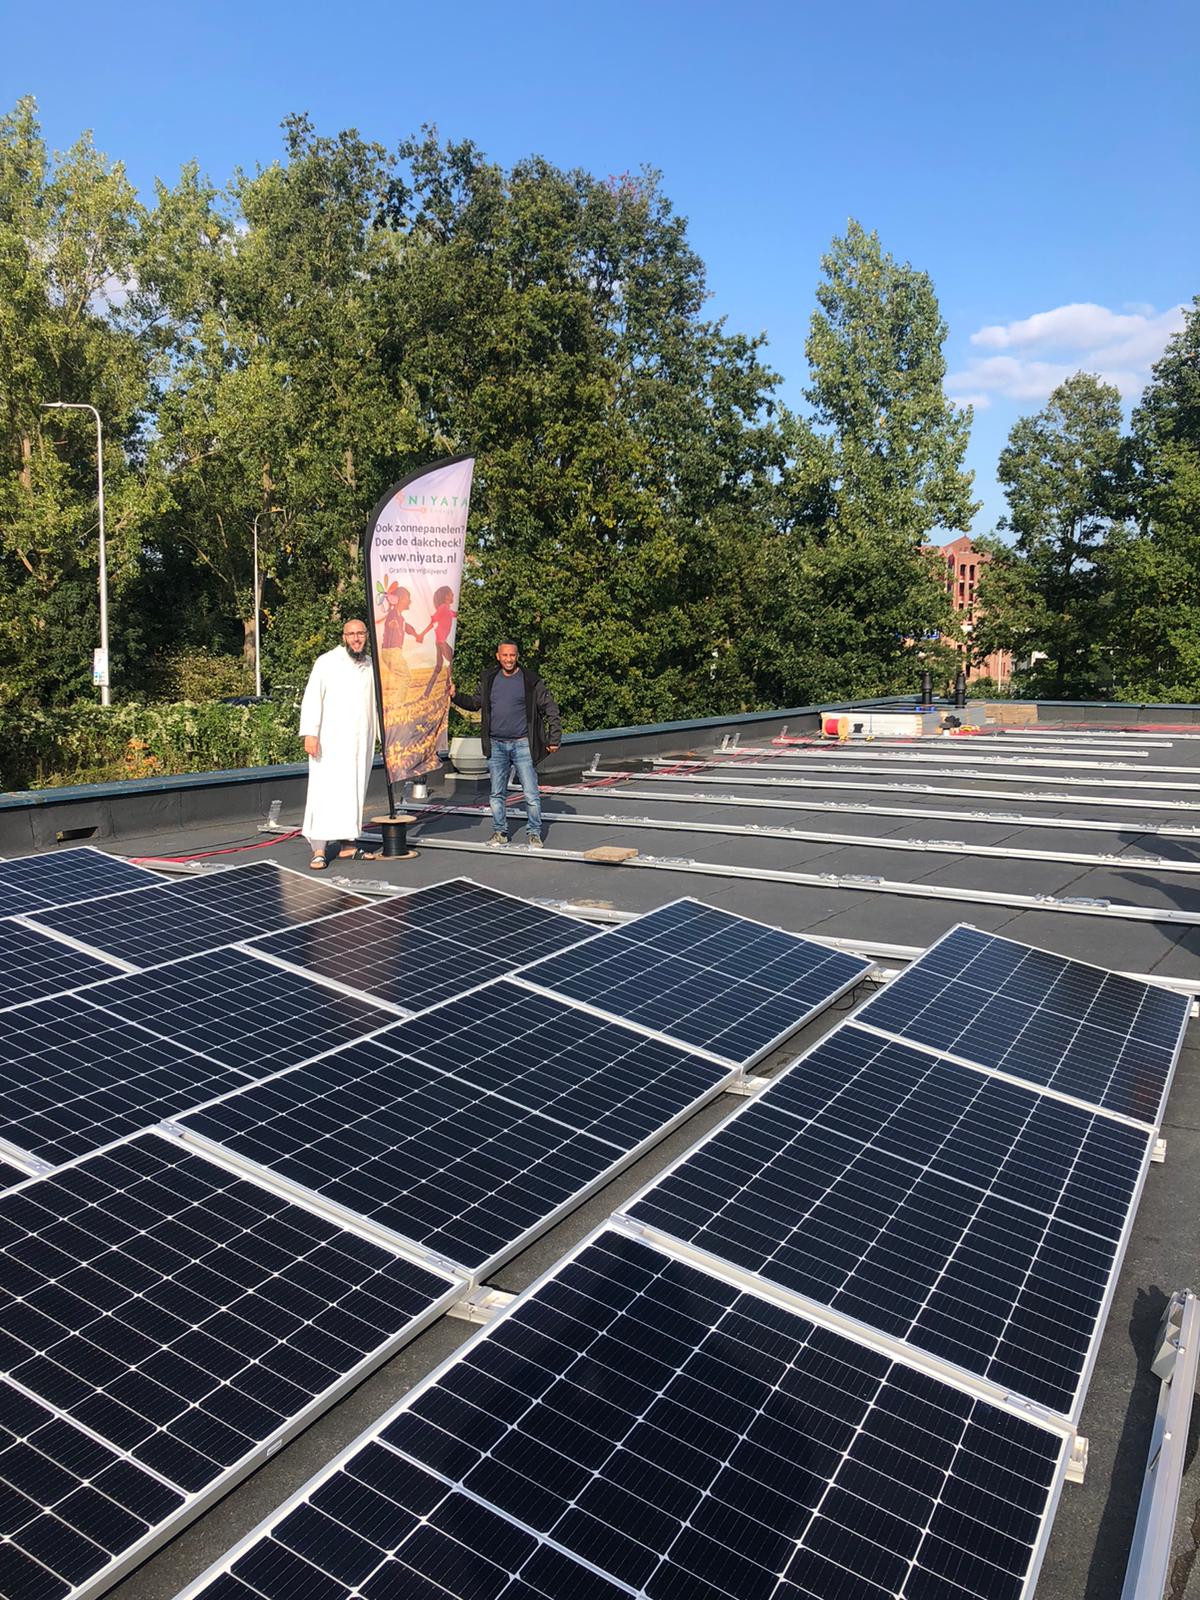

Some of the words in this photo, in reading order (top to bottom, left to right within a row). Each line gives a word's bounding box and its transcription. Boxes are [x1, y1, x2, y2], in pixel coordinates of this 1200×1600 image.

[408, 496, 468, 507] NIYATA
[375, 523, 393, 533] Ook
[395, 525, 465, 535] zonnepanelen?
[375, 537, 394, 547] Doe
[396, 536, 408, 546] de
[410, 537, 462, 548] dakcheck!
[379, 552, 457, 565] www.niyata.nl
